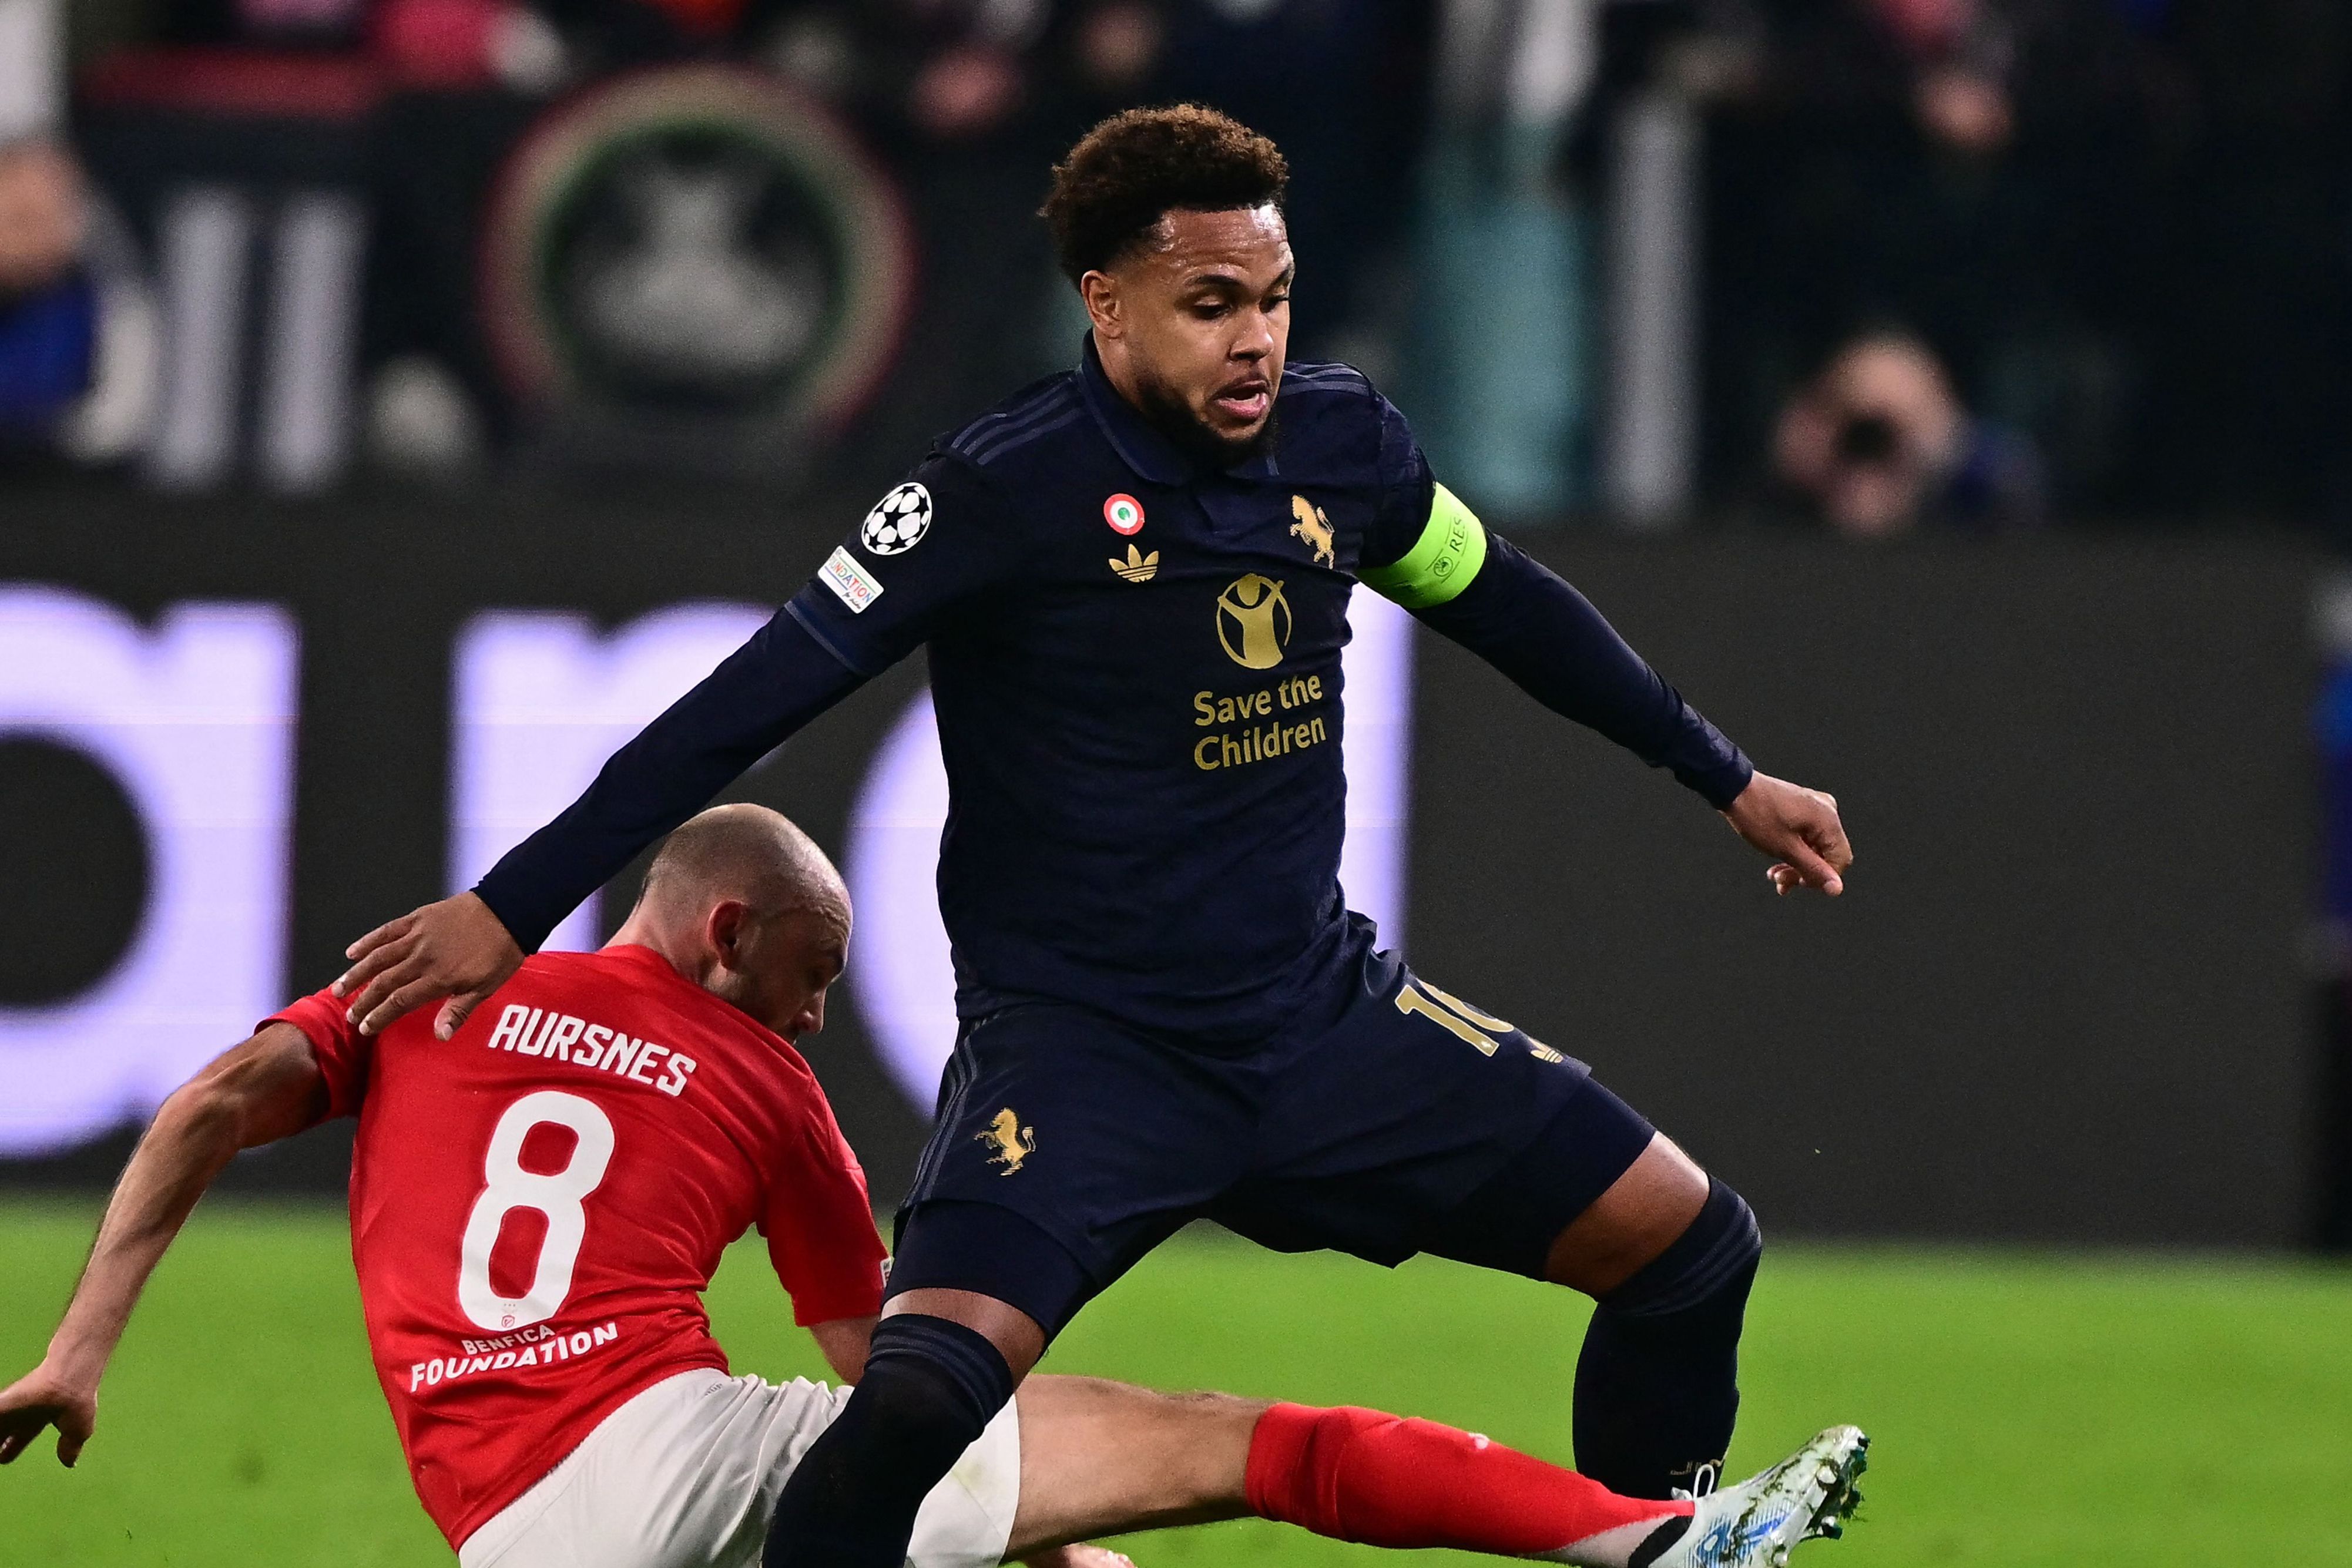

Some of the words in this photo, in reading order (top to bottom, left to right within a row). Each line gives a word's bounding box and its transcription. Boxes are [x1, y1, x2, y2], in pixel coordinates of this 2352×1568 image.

[1194, 690, 1272, 727] Save
[1278, 674, 1323, 709] the
[1194, 717, 1327, 770] Children
[488, 1003, 697, 1097] AURSNES
[458, 1090, 615, 1332] 8
[410, 1322, 618, 1392] FOUNDATION
[462, 1324, 555, 1355] BENFICA
